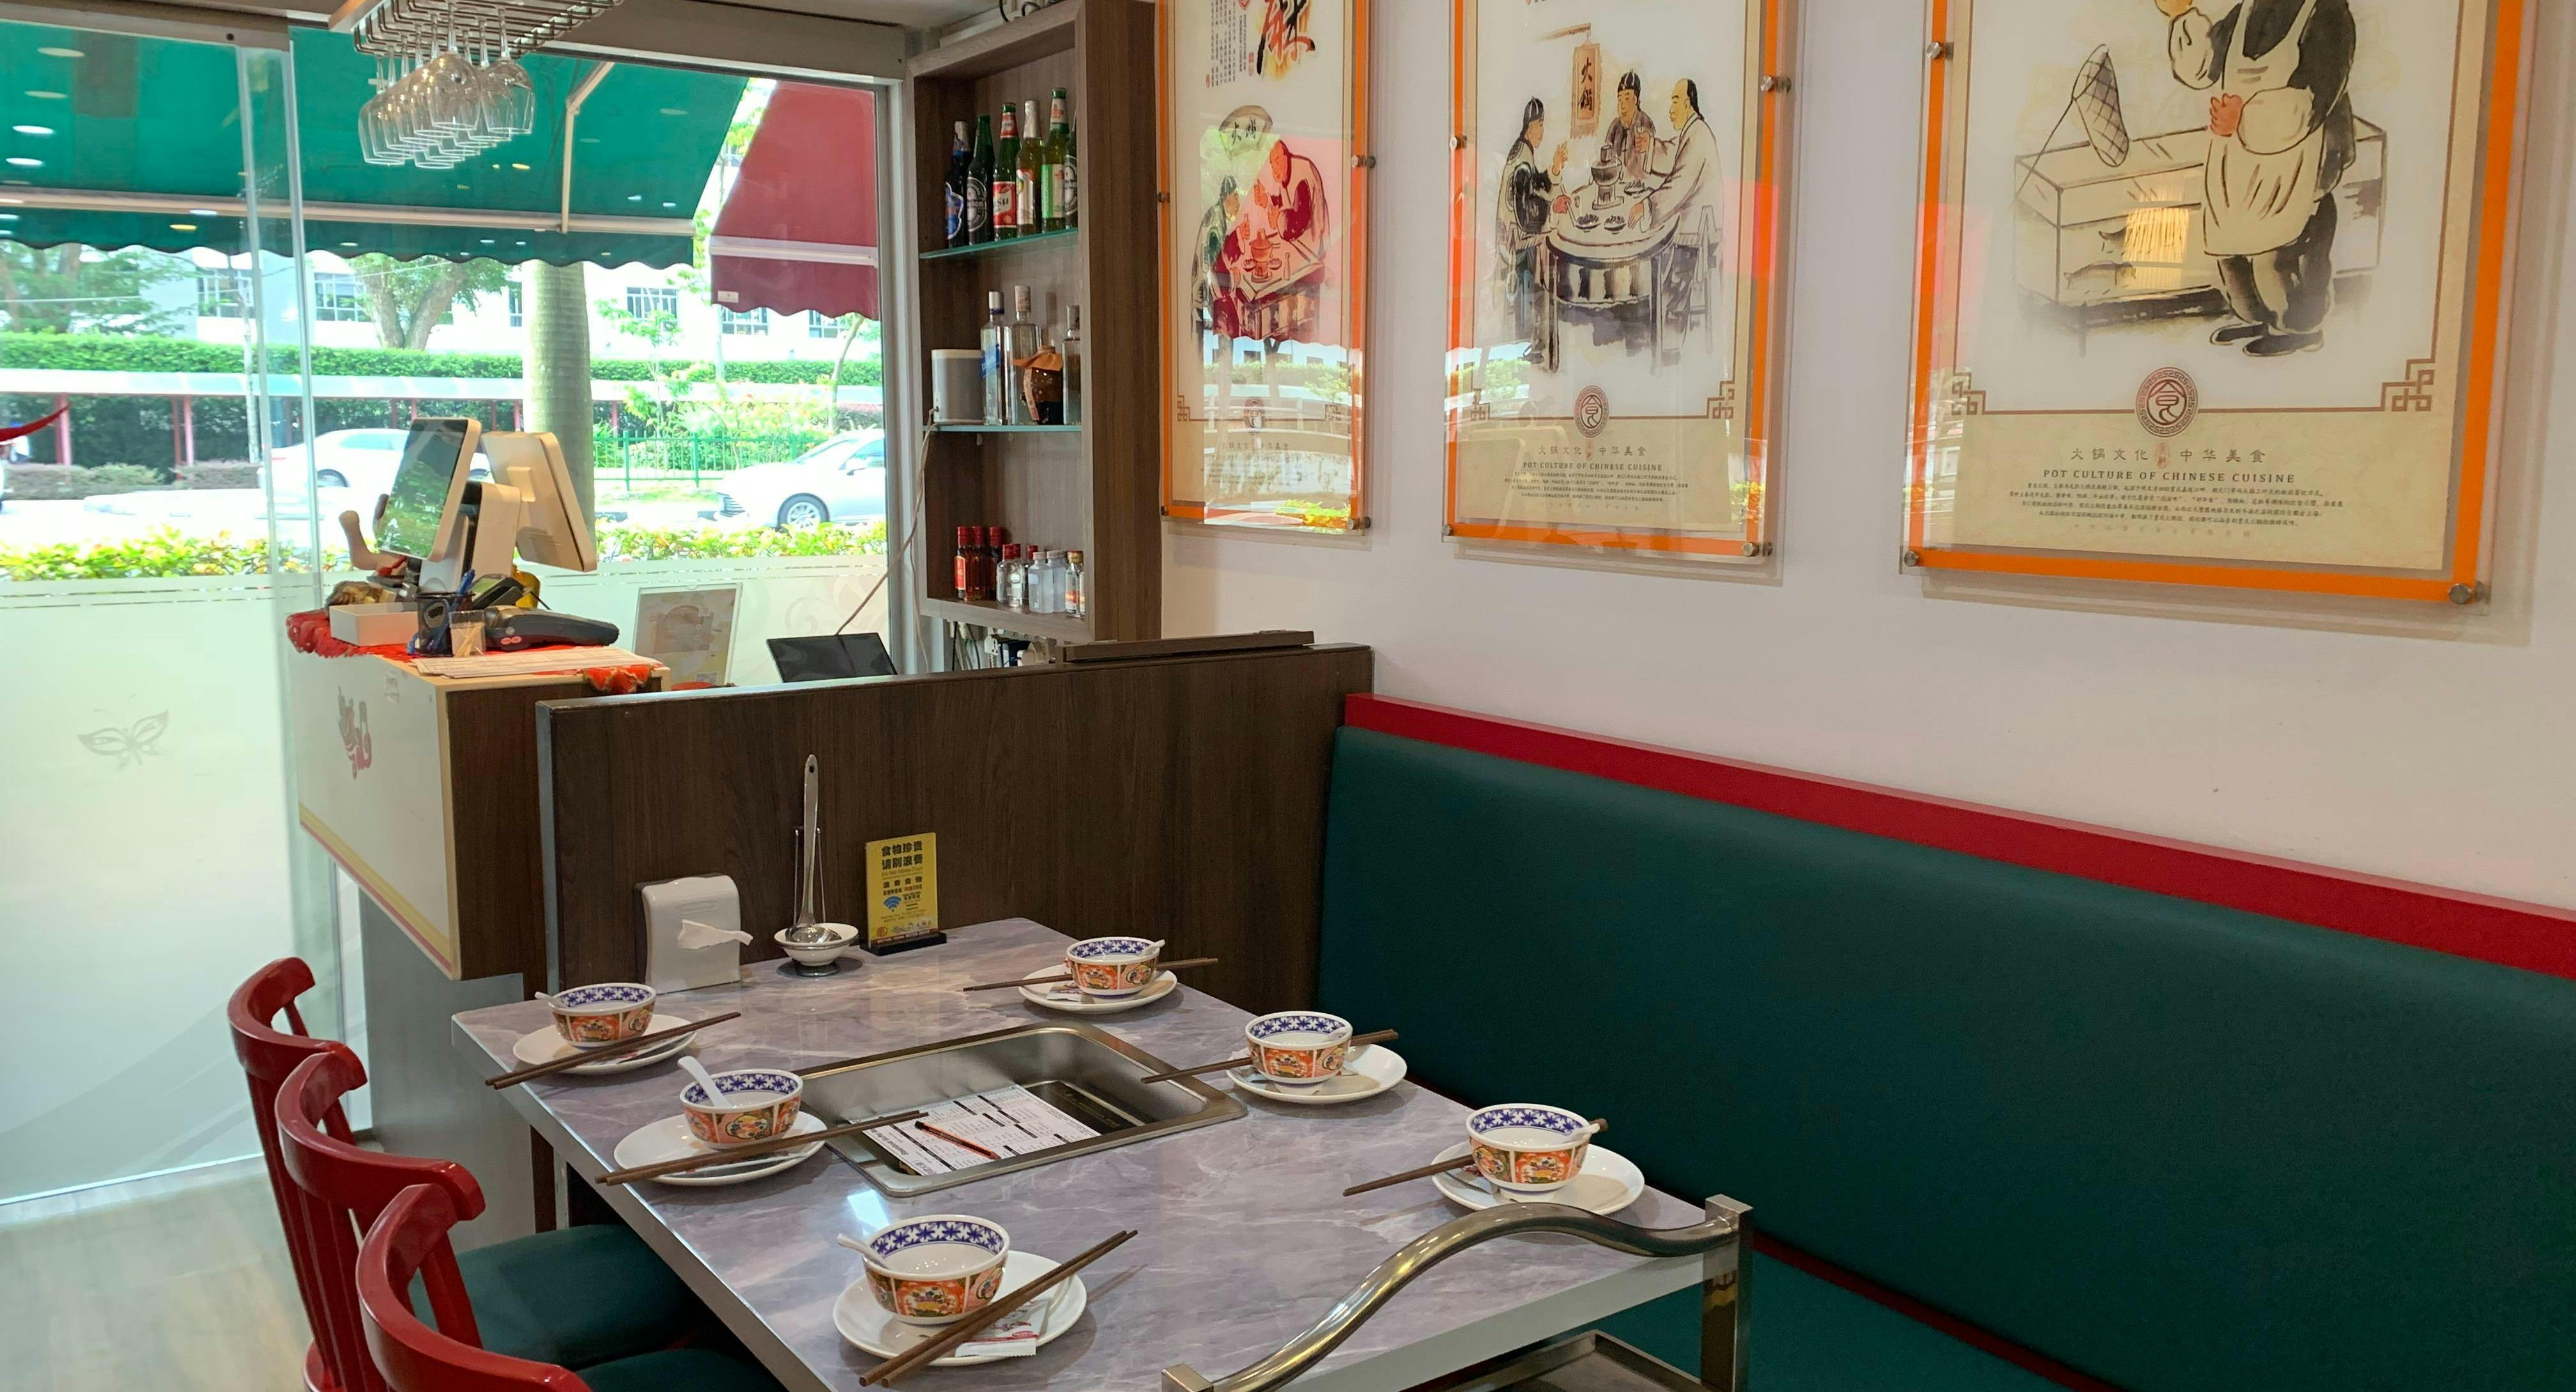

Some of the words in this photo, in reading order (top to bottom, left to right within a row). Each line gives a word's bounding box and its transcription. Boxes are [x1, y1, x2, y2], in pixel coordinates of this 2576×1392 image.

[1538, 445, 1583, 455] 火锅文化
[1599, 446, 1646, 457] 中华美食
[2071, 448, 2149, 461] 火锅文化
[2180, 448, 2266, 463] 中华美食
[2044, 470, 2067, 478] POT
[2073, 470, 2133, 479] CULTURE
[2139, 471, 2156, 480] OF
[2163, 472, 2225, 482] CHINESE
[2232, 473, 2295, 483] CUISINE
